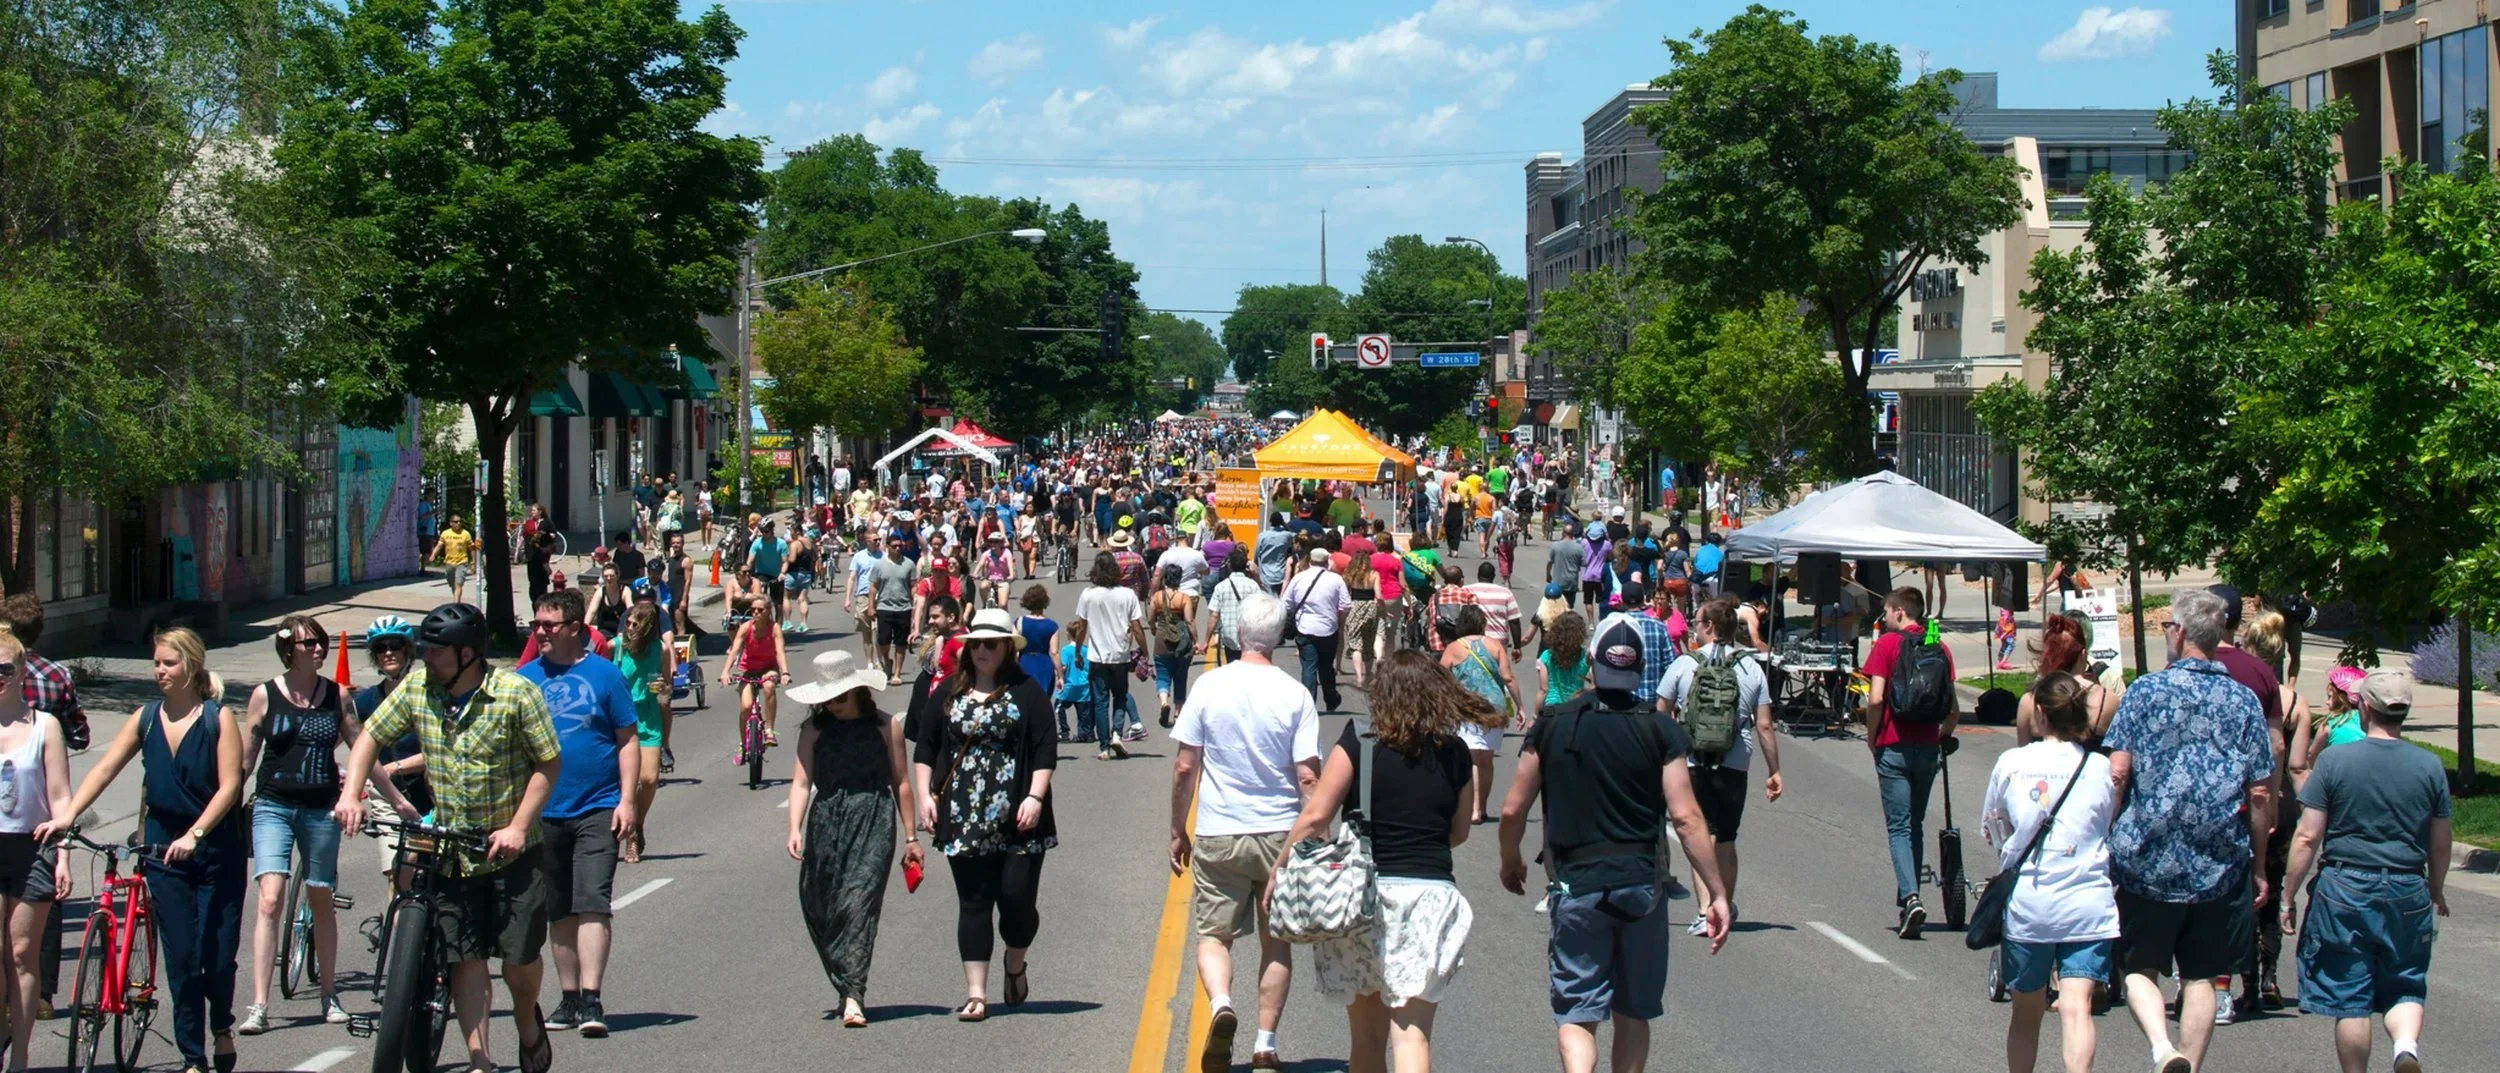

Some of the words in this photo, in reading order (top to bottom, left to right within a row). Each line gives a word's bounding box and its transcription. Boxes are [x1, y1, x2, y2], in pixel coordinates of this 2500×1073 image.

[1426, 356, 1434, 364] W
[1438, 356, 1460, 364] 28th
[1463, 355, 1473, 363] St
[1218, 500, 1260, 515] neighbor
[1227, 518, 1258, 526] DISAGREE
